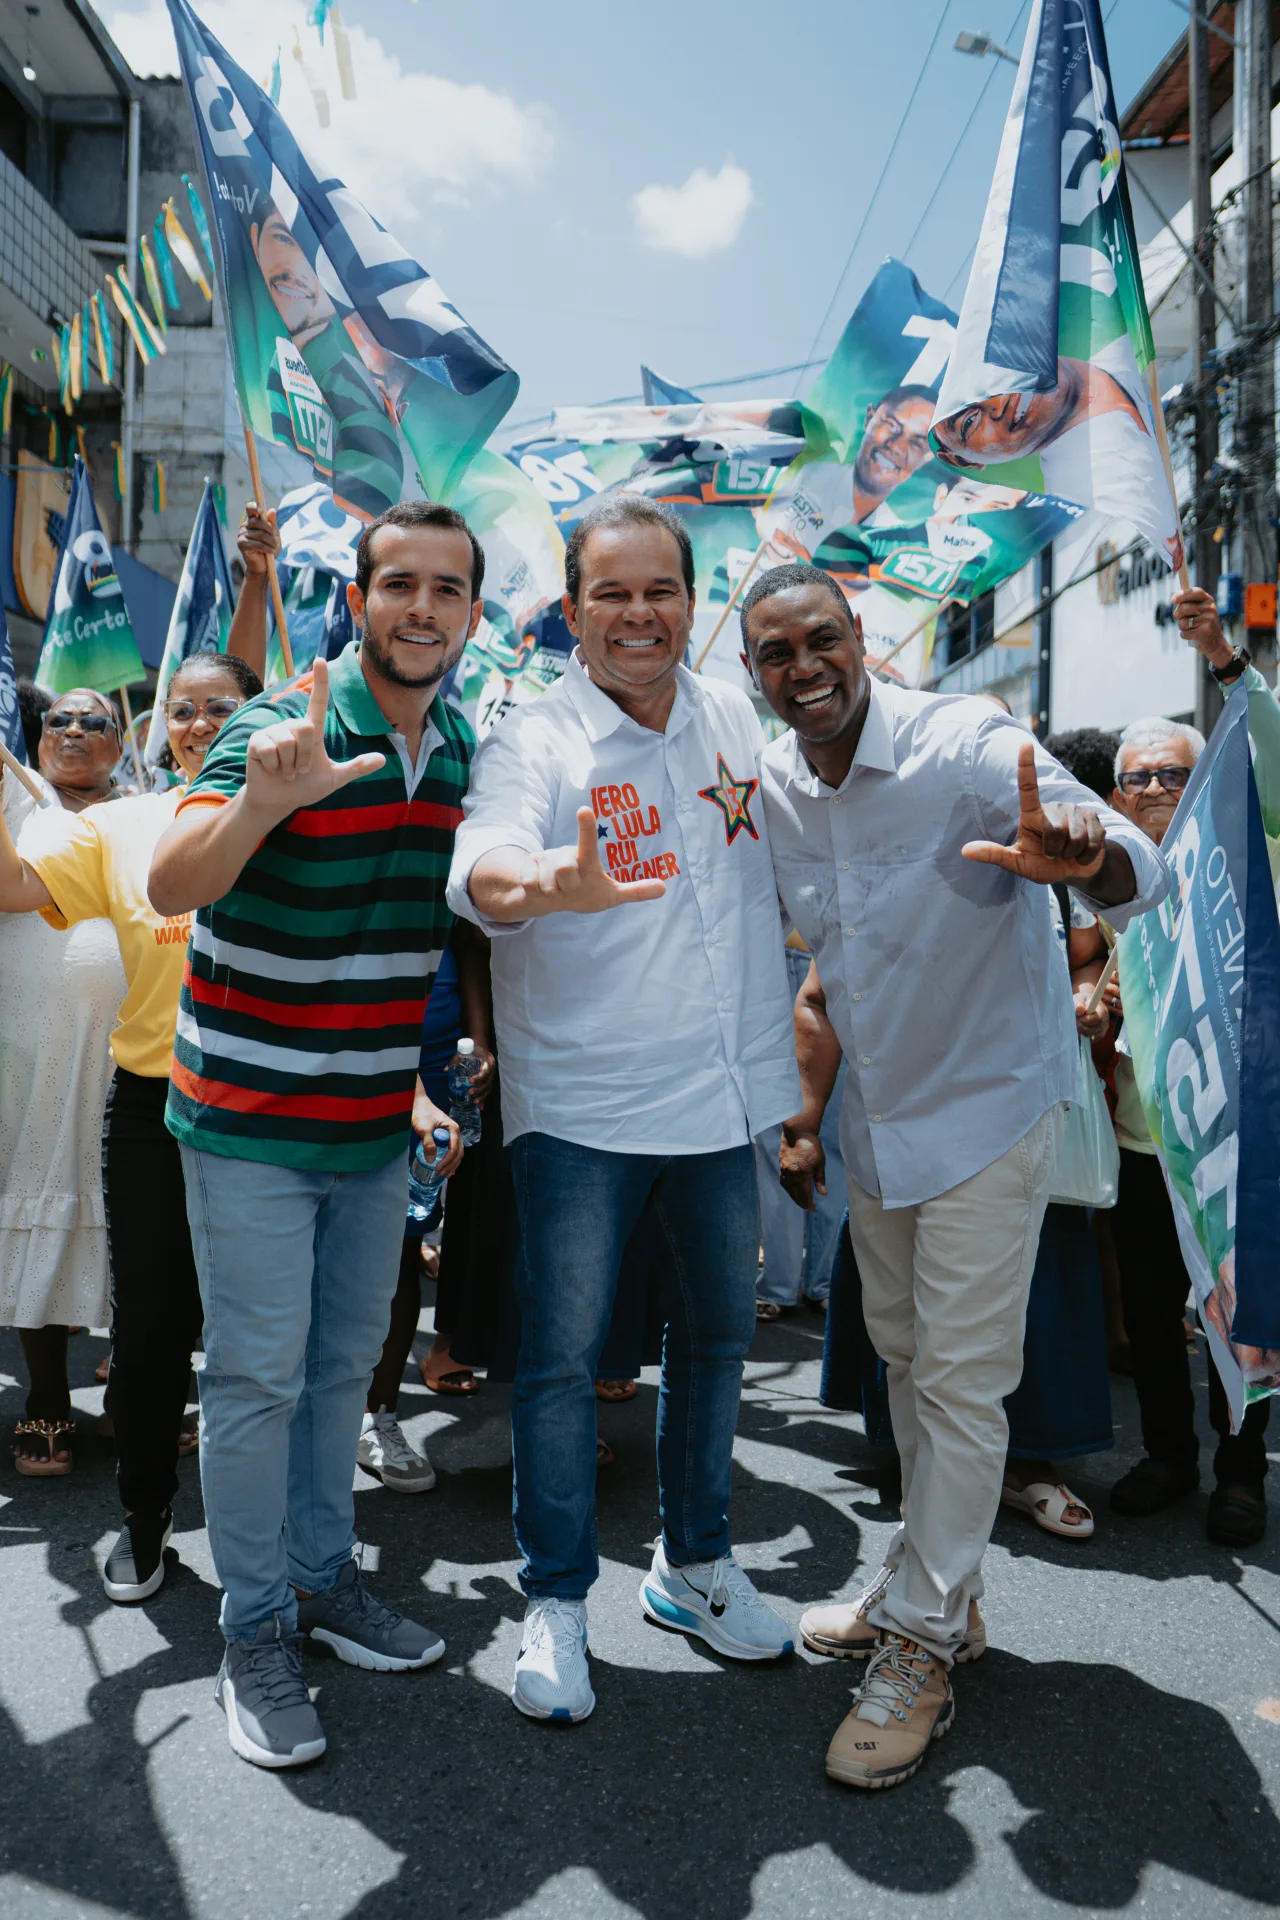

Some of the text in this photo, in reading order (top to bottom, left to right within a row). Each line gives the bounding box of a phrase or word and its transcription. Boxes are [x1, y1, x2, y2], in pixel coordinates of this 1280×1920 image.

[590, 782, 641, 821] JERO
[722, 787, 743, 817] 13
[611, 805, 662, 842] LULA
[605, 841, 639, 871] RUI
[854, 1741, 877, 1751] CAT
